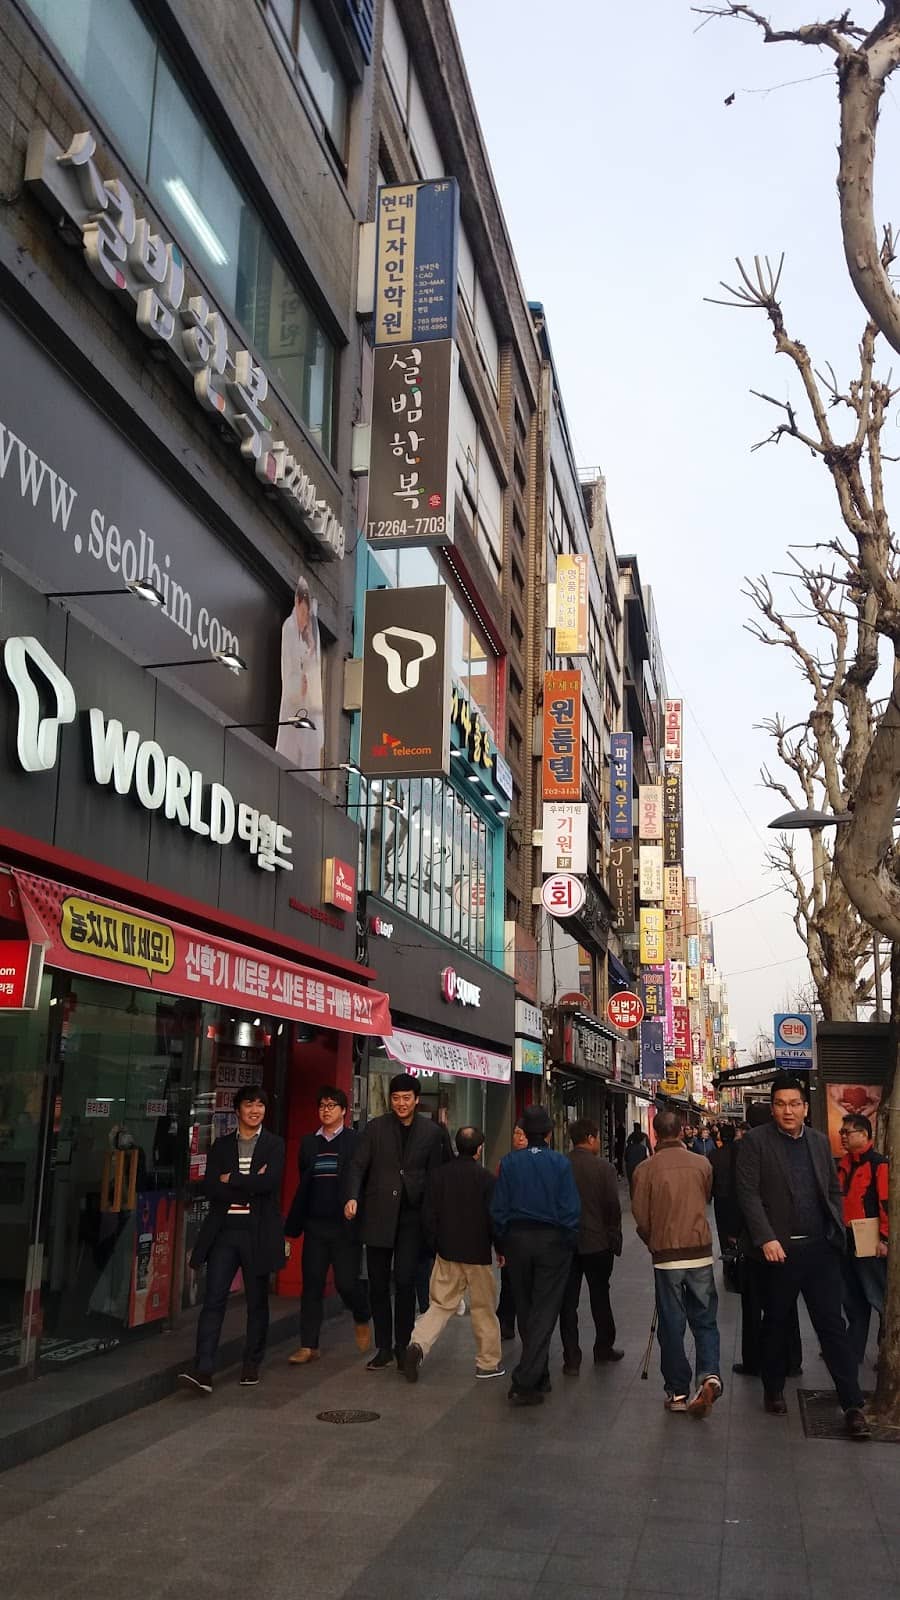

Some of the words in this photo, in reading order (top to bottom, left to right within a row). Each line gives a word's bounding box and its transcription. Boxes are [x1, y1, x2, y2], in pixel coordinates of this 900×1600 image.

[433, 183, 449, 193] 3F
[381, 193, 413, 213] 현대
[381, 216, 407, 335] 디자인학원
[388, 347, 426, 510] 설빔한복
[368, 516, 446, 538] T.2264-7703
[393, 744, 432, 756] telecom
[548, 698, 576, 783] 원룸텔
[90, 708, 235, 845] WORLD
[238, 803, 293, 872] 티월드
[555, 816, 573, 854] 기원
[550, 880, 572, 909] 회
[69, 897, 118, 951] 놓치지
[121, 922, 136, 956] 마
[138, 928, 169, 965] 세요!
[185, 942, 229, 989] 신학기
[232, 957, 270, 999] 새로운
[271, 969, 304, 1007] 스마트
[306, 978, 325, 1013] 폰을
[610, 1000, 641, 1014] 일번가
[614, 1014, 637, 1023] 귀금속
[782, 1024, 804, 1036] 담배
